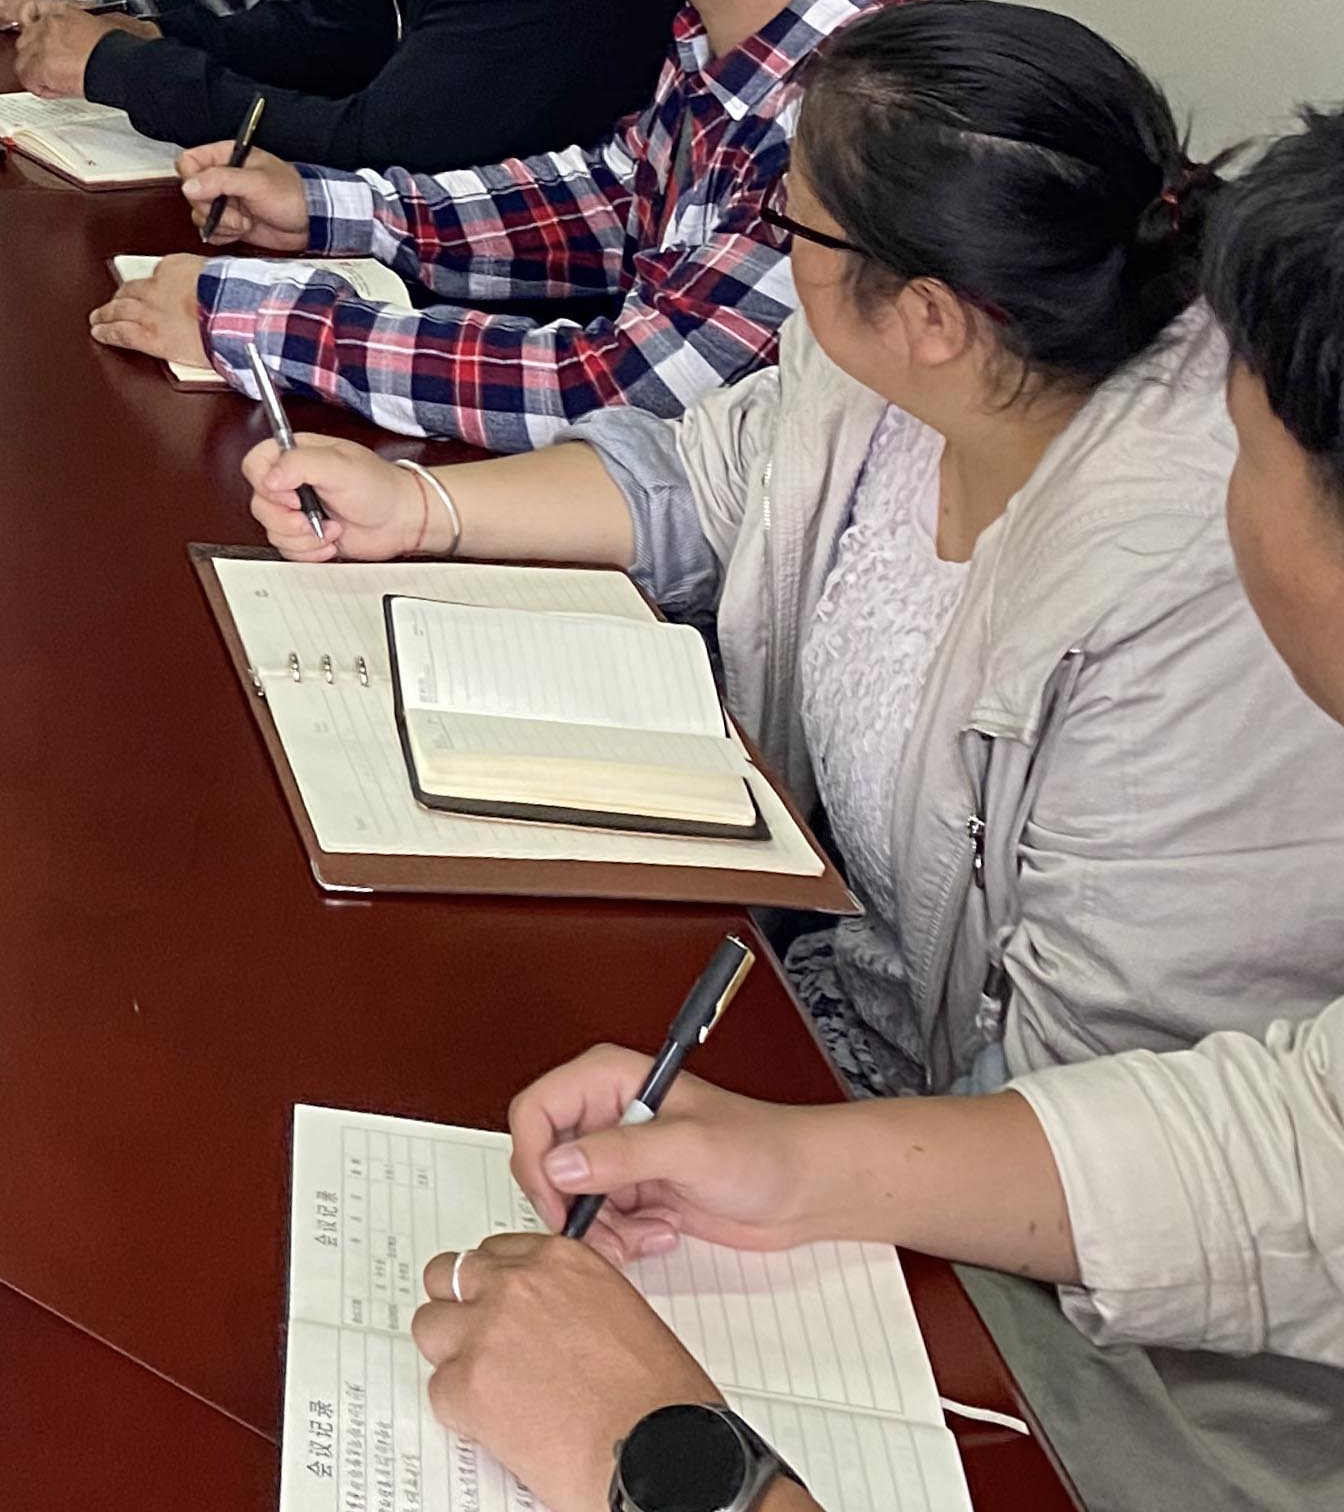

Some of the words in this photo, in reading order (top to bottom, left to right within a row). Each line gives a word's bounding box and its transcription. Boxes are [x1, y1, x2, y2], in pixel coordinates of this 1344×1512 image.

[314, 1190, 341, 1248] 会议记录
[306, 1399, 334, 1480] 会议记录
